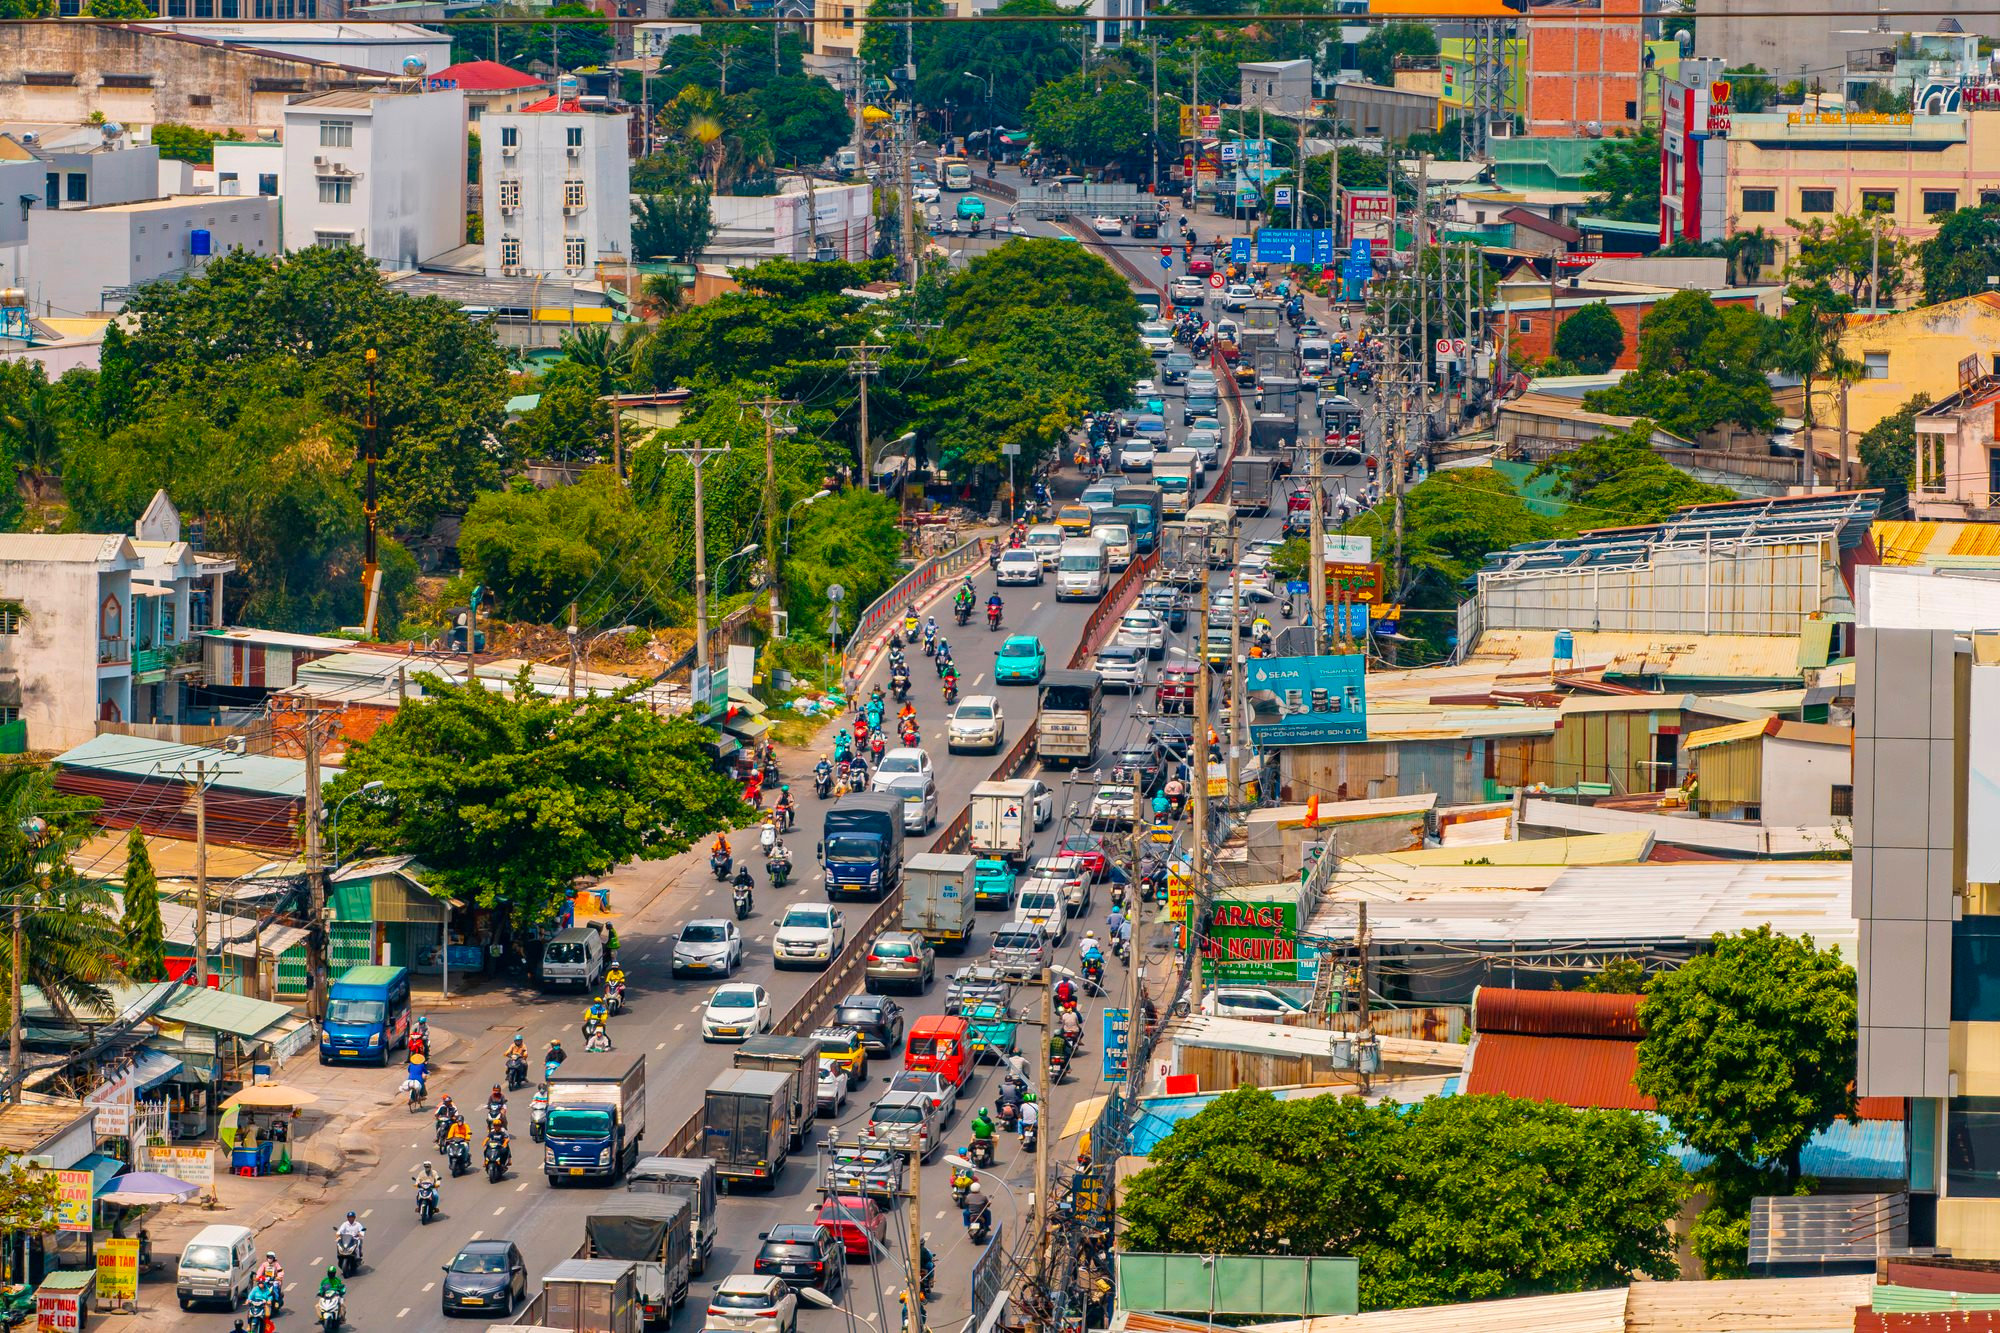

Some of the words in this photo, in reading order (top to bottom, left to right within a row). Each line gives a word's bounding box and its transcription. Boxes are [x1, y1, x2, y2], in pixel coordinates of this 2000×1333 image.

[1707, 118, 1731, 129] KHOA
[1268, 670, 1299, 679] SEAPA
[1213, 905, 1284, 927] ARAGE
[58, 1171, 88, 1185] CƠM
[60, 1185, 87, 1200] TẤM
